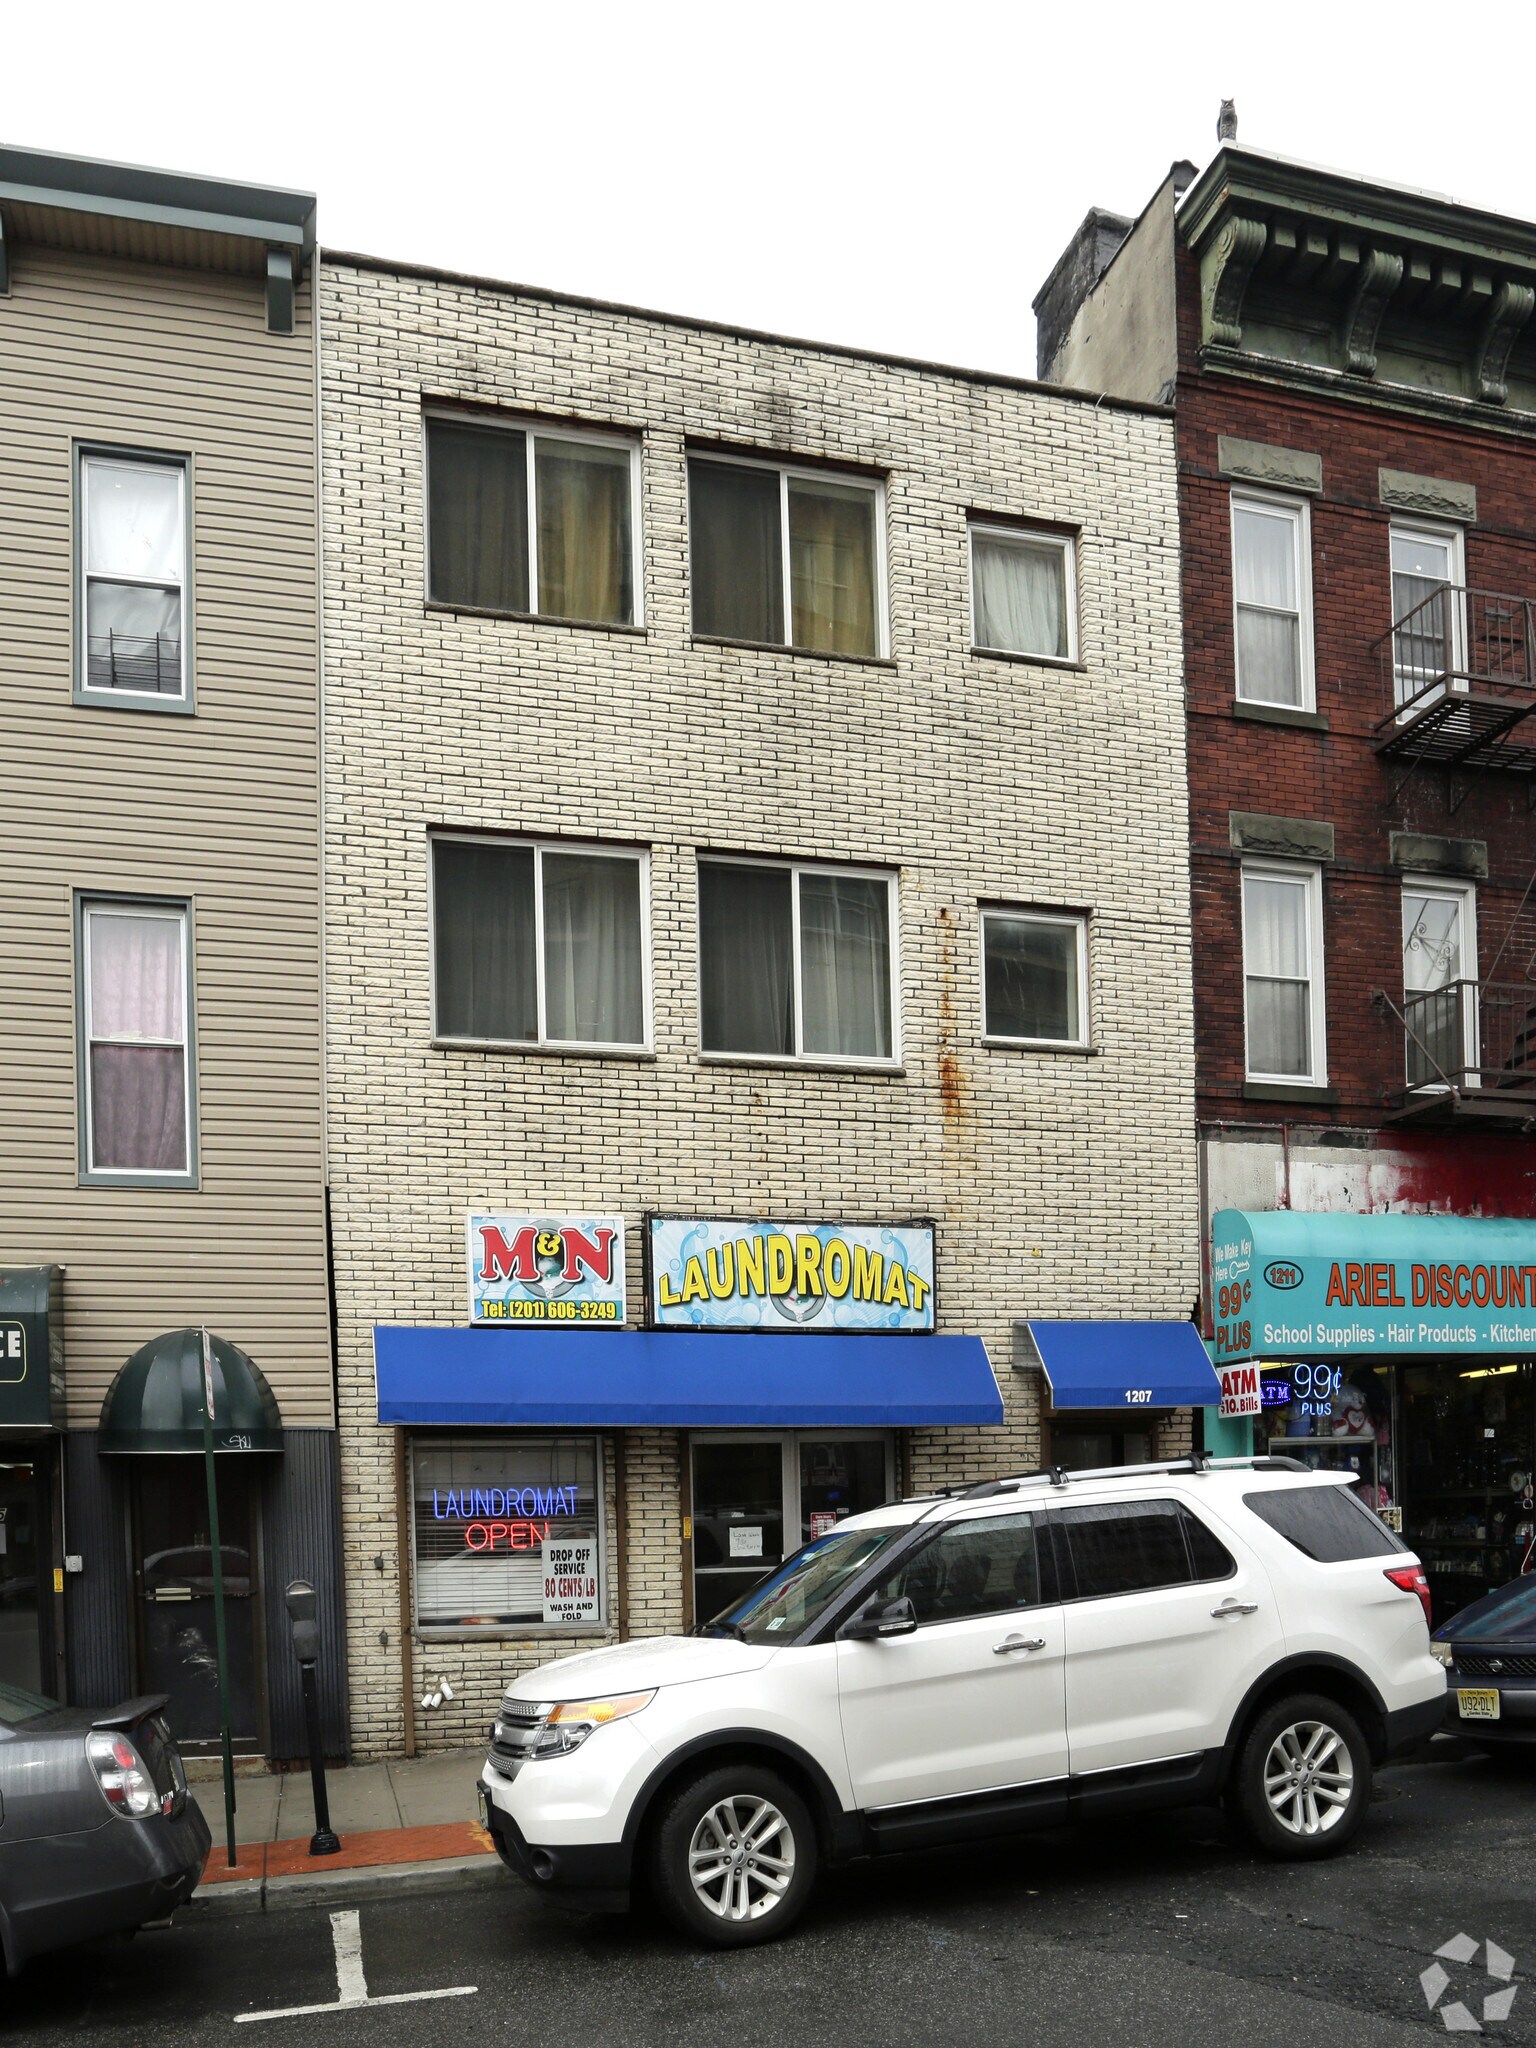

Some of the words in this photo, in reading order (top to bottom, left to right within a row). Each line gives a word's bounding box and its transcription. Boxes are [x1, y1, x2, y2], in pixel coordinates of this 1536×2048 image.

[1215, 1246, 1224, 1263] We
[1224, 1242, 1239, 1260] Make
[1240, 1238, 1252, 1258] Key
[658, 1233, 931, 1312] LAUNDROMAT
[1215, 1266, 1228, 1282] Here
[1270, 1267, 1296, 1285] 1211
[1325, 1262, 1405, 1307] ARIEL
[1411, 1264, 1536, 1309] DISCOUNT
[481, 1300, 507, 1318] Tel:
[509, 1301, 545, 1319] (201)
[547, 1301, 616, 1319] 606-3249
[0, 1330, 21, 1358] E
[1217, 1320, 1252, 1354] PLUS
[1264, 1323, 1312, 1344] School
[1316, 1323, 1376, 1347] Supplies
[1387, 1323, 1415, 1343] Hair
[1418, 1323, 1477, 1343] Products
[1490, 1323, 1536, 1343] Kitchen
[1222, 1368, 1257, 1397] ATM
[1125, 1390, 1152, 1402] 1207
[1240, 1396, 1258, 1412] Bills
[1301, 1402, 1332, 1415] PLUS
[433, 1486, 578, 1519] LAUNDROMAT
[466, 1522, 549, 1550] OPEN
[550, 1549, 573, 1562] DROP
[575, 1548, 591, 1562] OFF
[554, 1562, 586, 1576] SERVICE
[545, 1577, 556, 1599] 80
[558, 1577, 596, 1598] CENTS/LB
[549, 1603, 574, 1612] WASH
[575, 1602, 593, 1611] AND
[561, 1612, 582, 1621] FOLD
